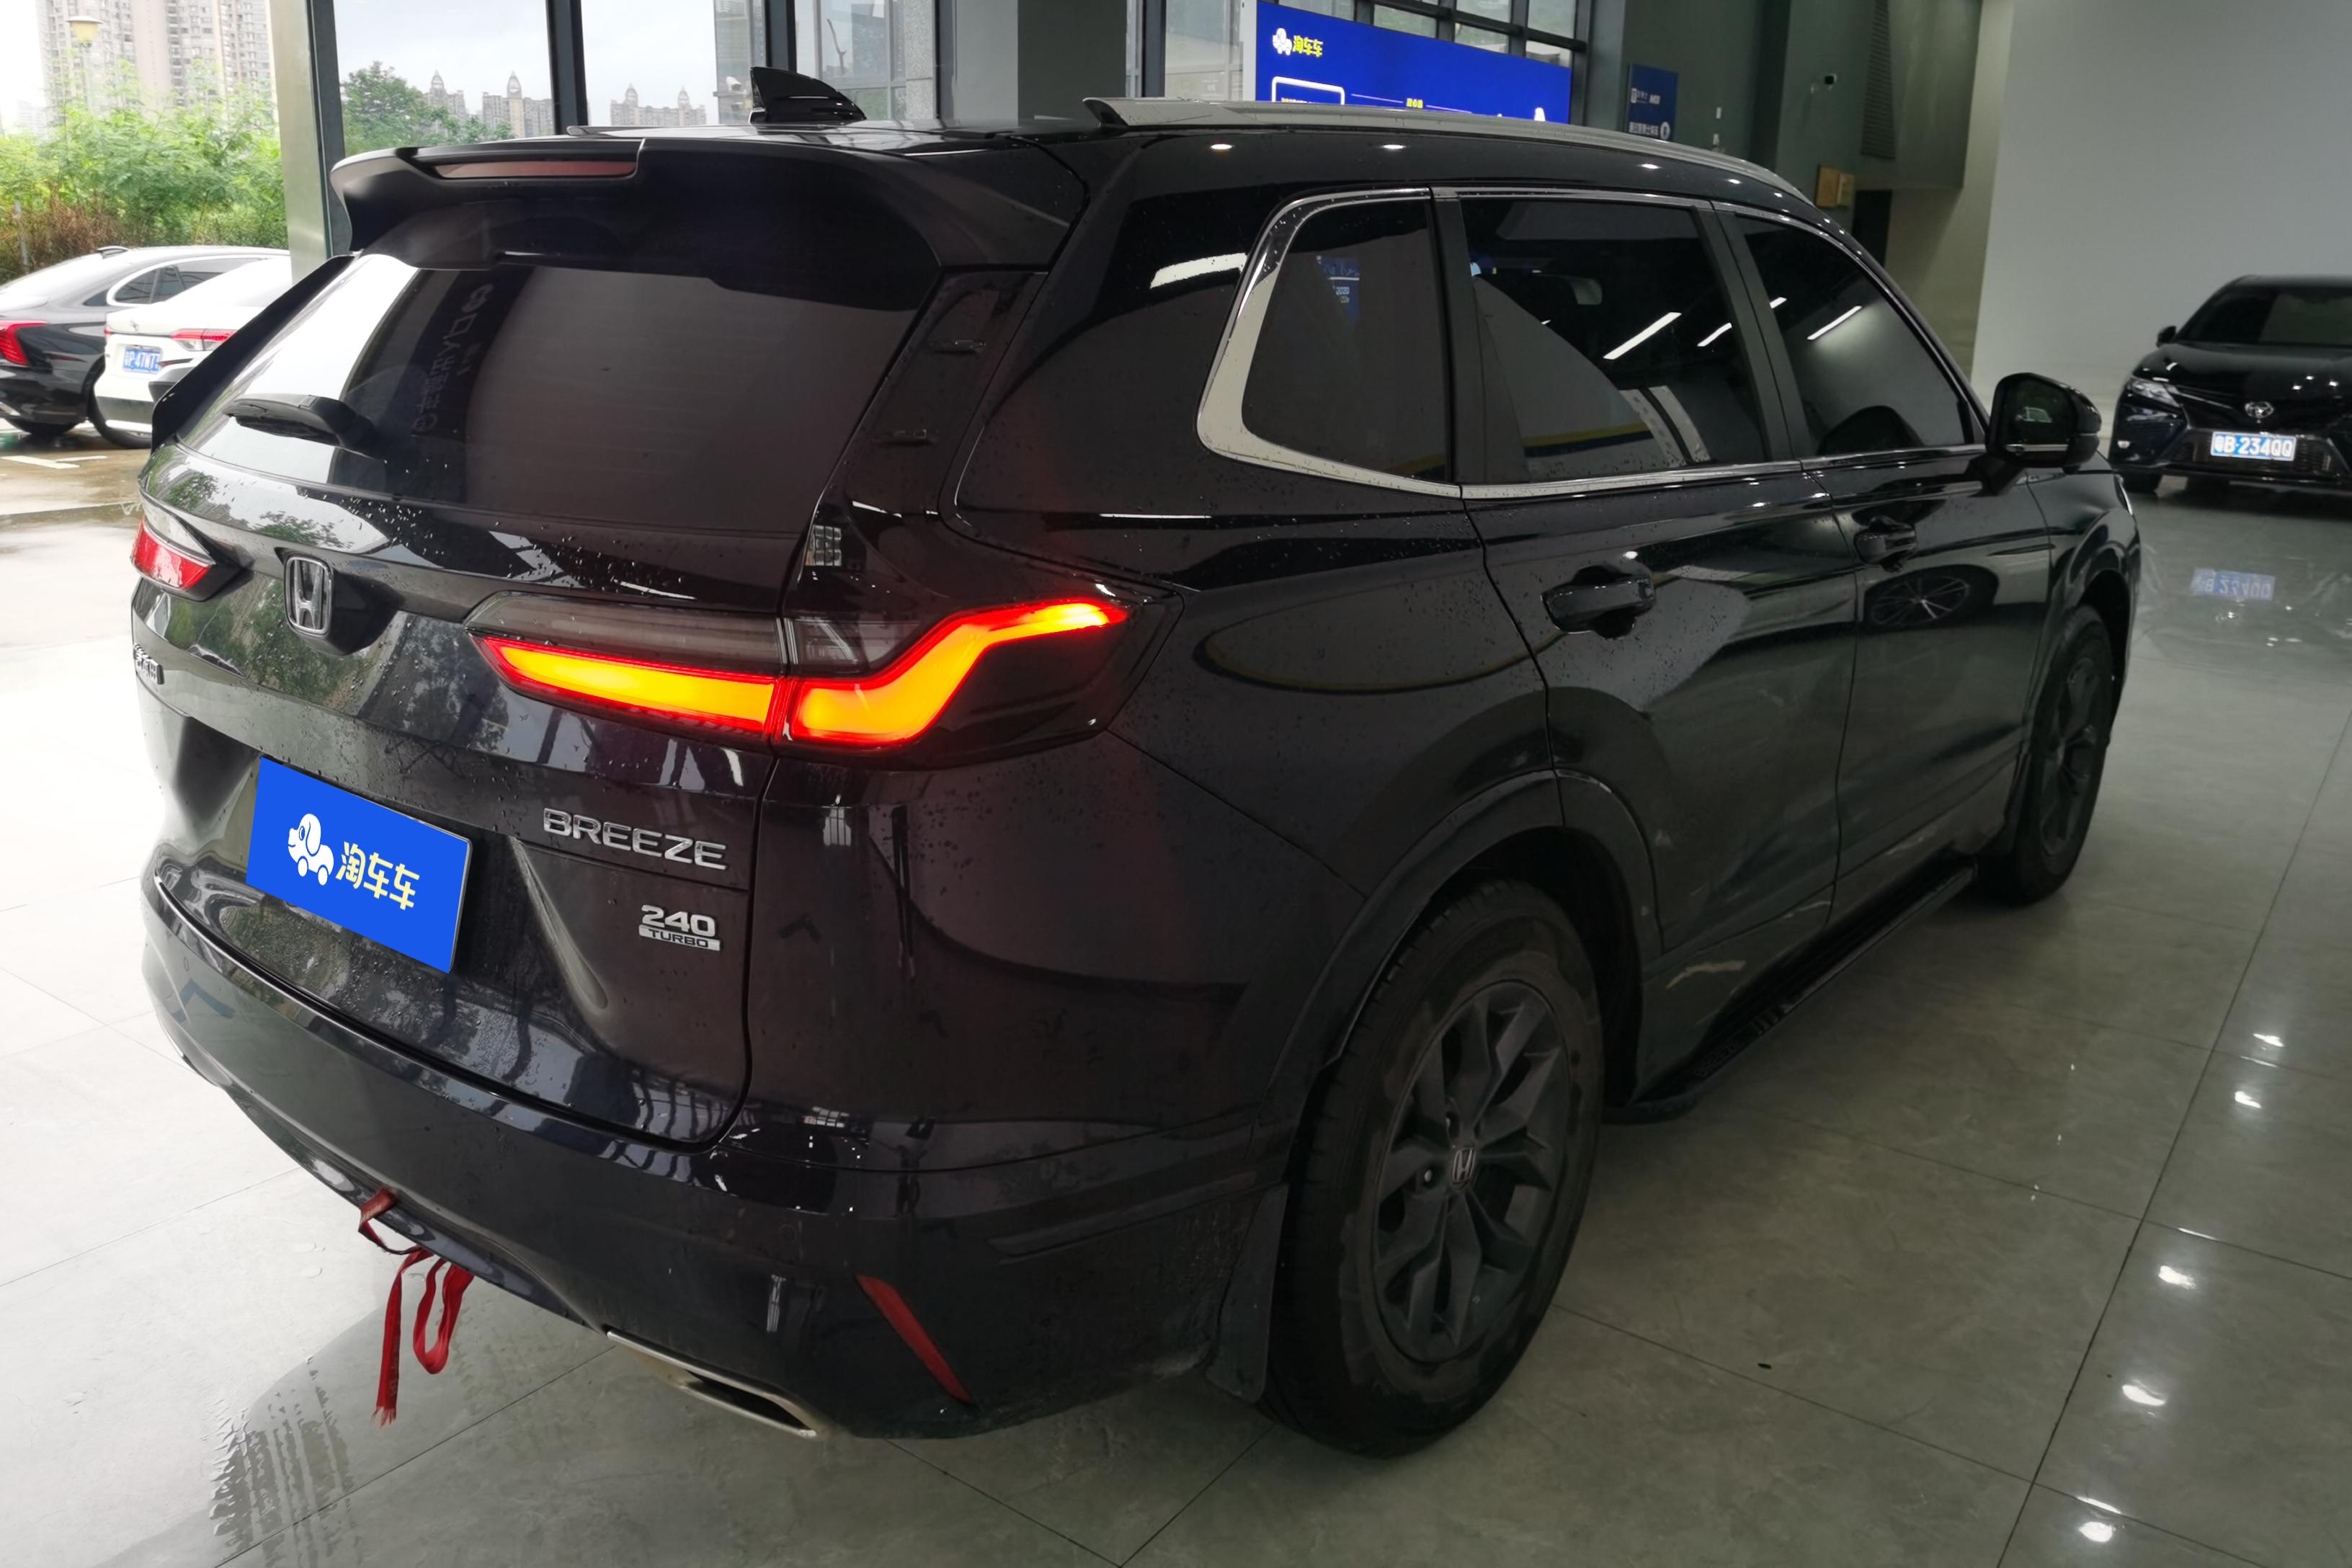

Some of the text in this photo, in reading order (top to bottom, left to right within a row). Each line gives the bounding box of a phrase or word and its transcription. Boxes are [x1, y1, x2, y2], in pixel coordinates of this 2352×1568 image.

[1292, 35, 1324, 58] 淘车车
[543, 808, 726, 870] BREEZE
[641, 904, 716, 937] 240
[649, 928, 709, 948] TURBO
